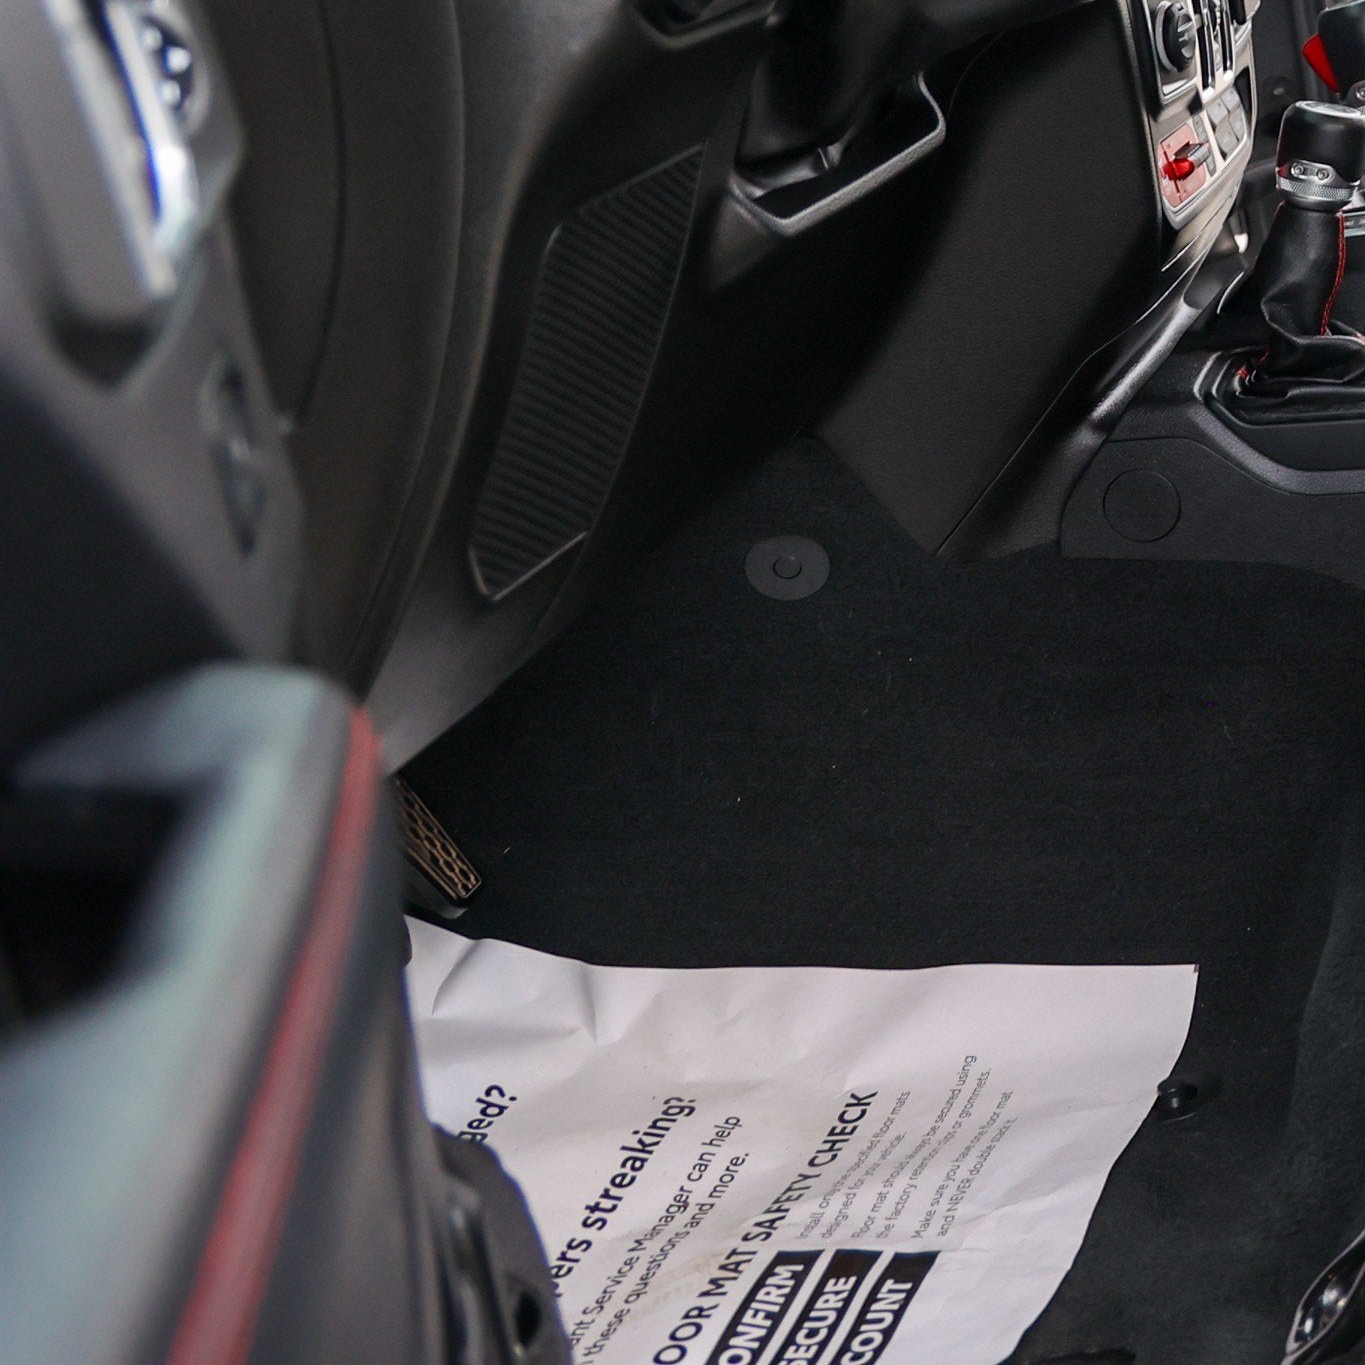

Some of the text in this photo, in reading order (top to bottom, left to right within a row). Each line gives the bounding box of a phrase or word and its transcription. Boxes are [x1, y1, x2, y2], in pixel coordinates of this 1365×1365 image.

[701, 1115, 742, 1148] help
[871, 1190, 889, 1213] mat
[934, 1088, 962, 1124] secured
[955, 1054, 977, 1086] using
[891, 1090, 911, 1116] mats
[549, 1096, 697, 1298] ers streaking?
[687, 1152, 716, 1182] can
[697, 1247, 758, 1298] MAT
[741, 1172, 822, 1242] SAFETY
[807, 1091, 879, 1169] CHECK
[910, 1210, 936, 1239] Make
[930, 1183, 949, 1207] sure
[945, 1160, 961, 1183] you
[627, 1185, 693, 1253] Manager
[885, 1183, 917, 1221] factory
[937, 1214, 955, 1237] and
[947, 1176, 974, 1212] NEVER
[582, 1256, 640, 1315] Service
[583, 1152, 750, 1356] these questions and more.
[840, 1279, 913, 1365] COUNT
